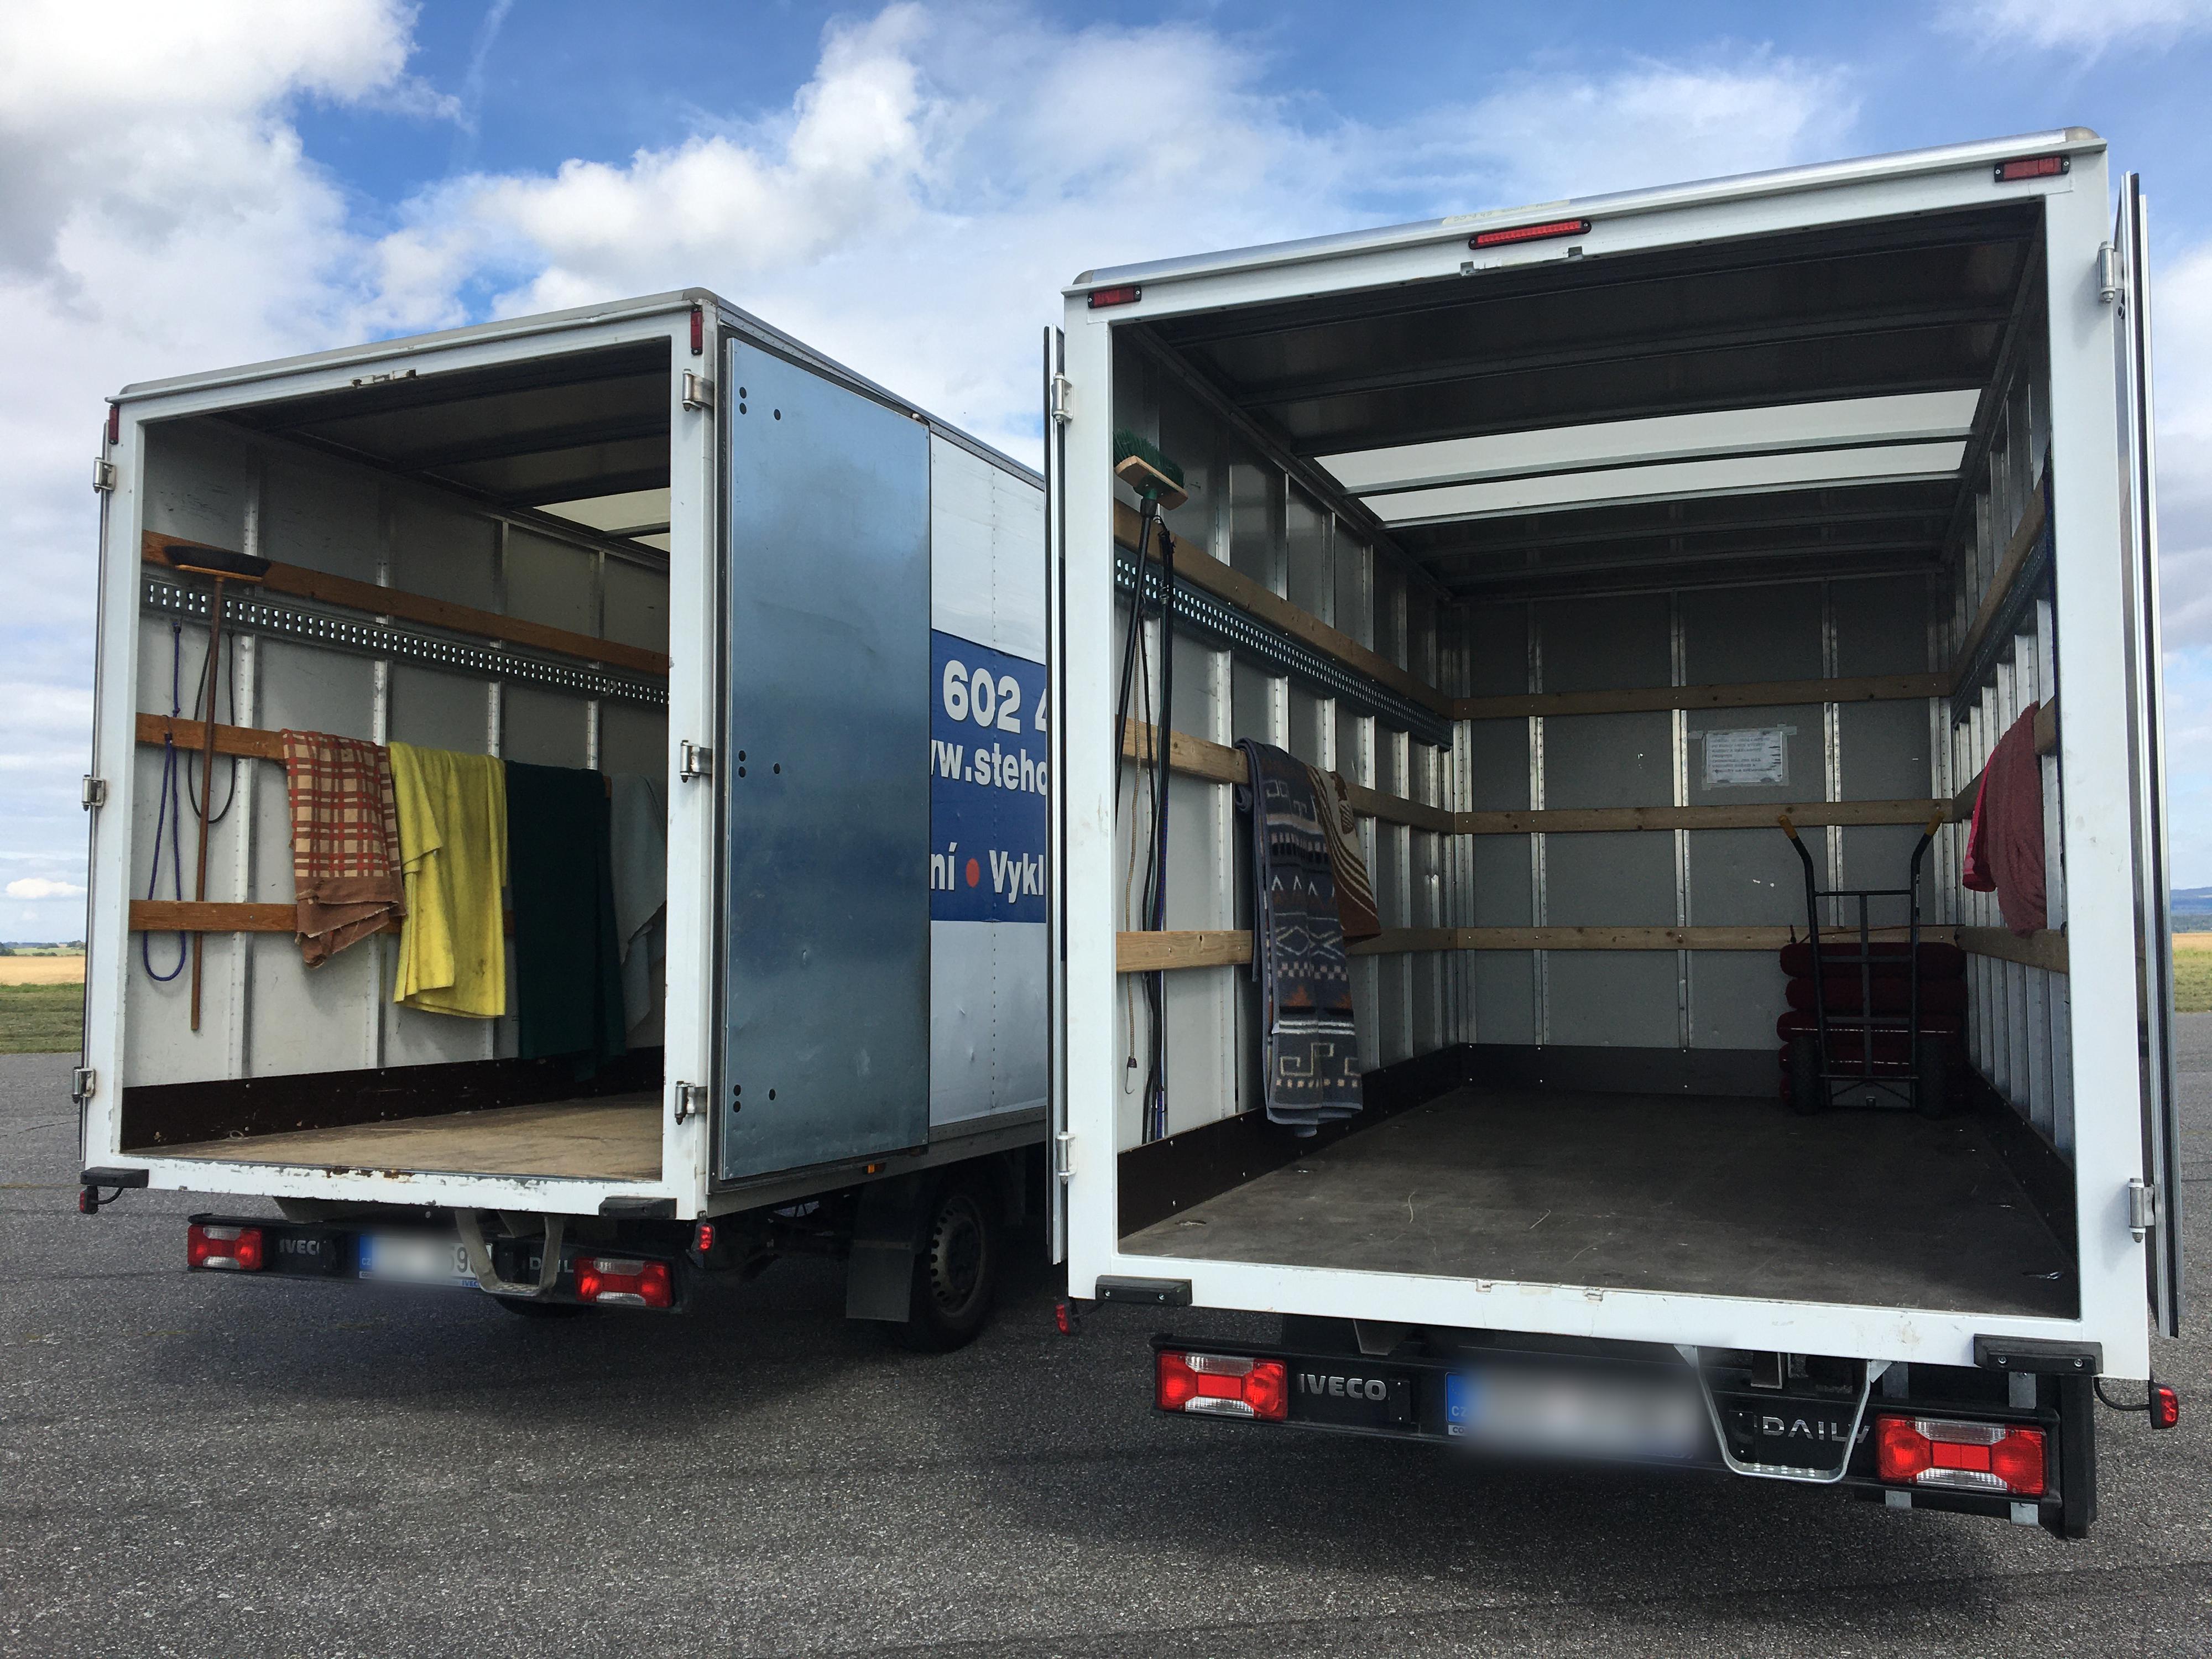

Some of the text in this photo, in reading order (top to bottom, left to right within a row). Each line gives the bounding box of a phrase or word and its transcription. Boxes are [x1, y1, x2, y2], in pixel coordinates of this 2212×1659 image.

[943, 660, 1020, 733] 602
[931, 739, 1046, 795] w.steho
[989, 850, 1044, 903] Vykl
[279, 1239, 320, 1255] IVEC
[1297, 1373, 1386, 1401] IVECO
[1452, 1406, 1468, 1417] CZ
